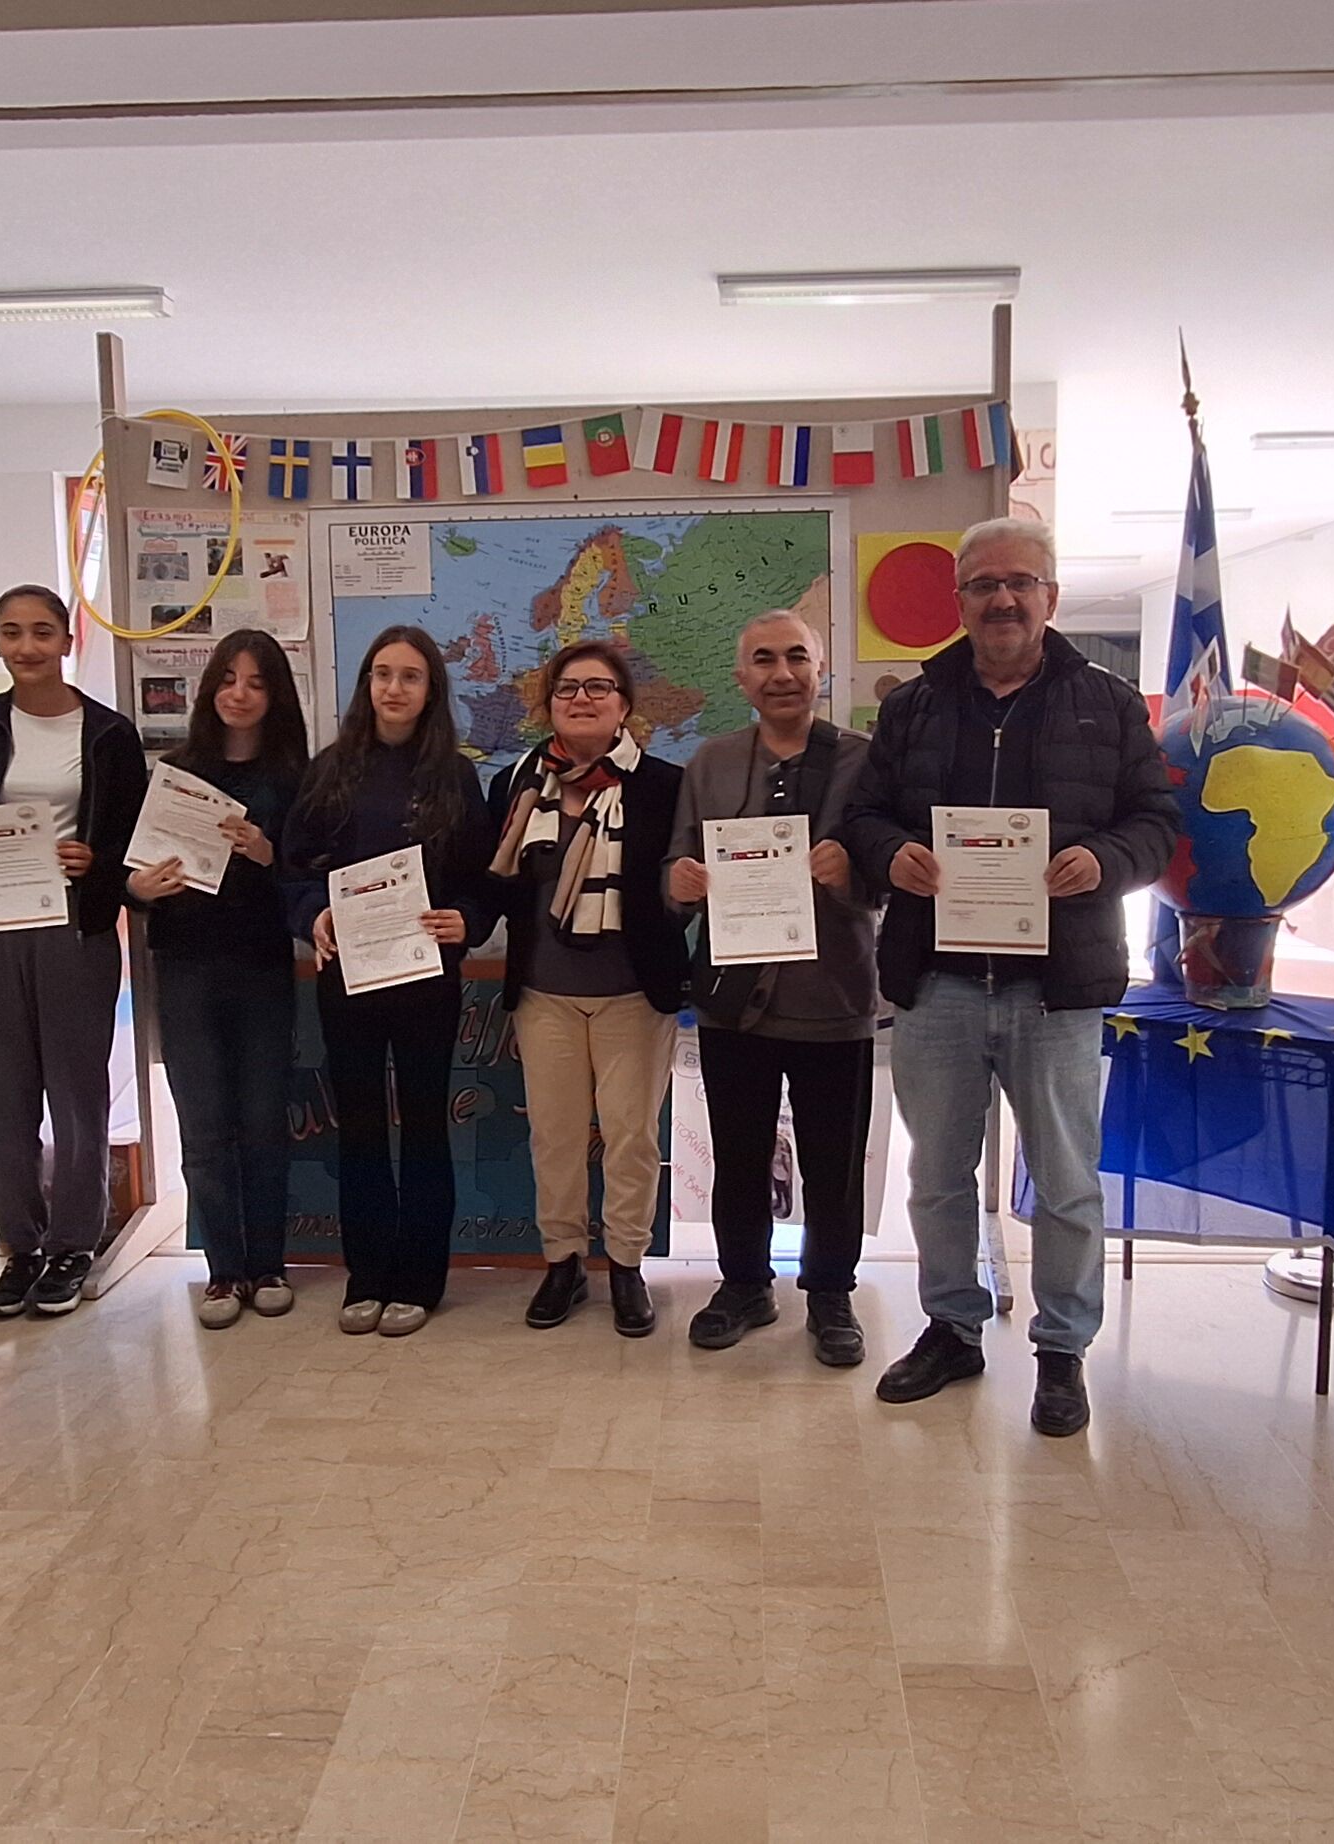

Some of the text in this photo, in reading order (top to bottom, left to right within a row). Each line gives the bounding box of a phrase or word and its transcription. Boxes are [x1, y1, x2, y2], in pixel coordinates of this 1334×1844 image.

[348, 525, 411, 538] EUROPA
[355, 537, 407, 546] POLITICA
[648, 539, 795, 615] RUSSIA
